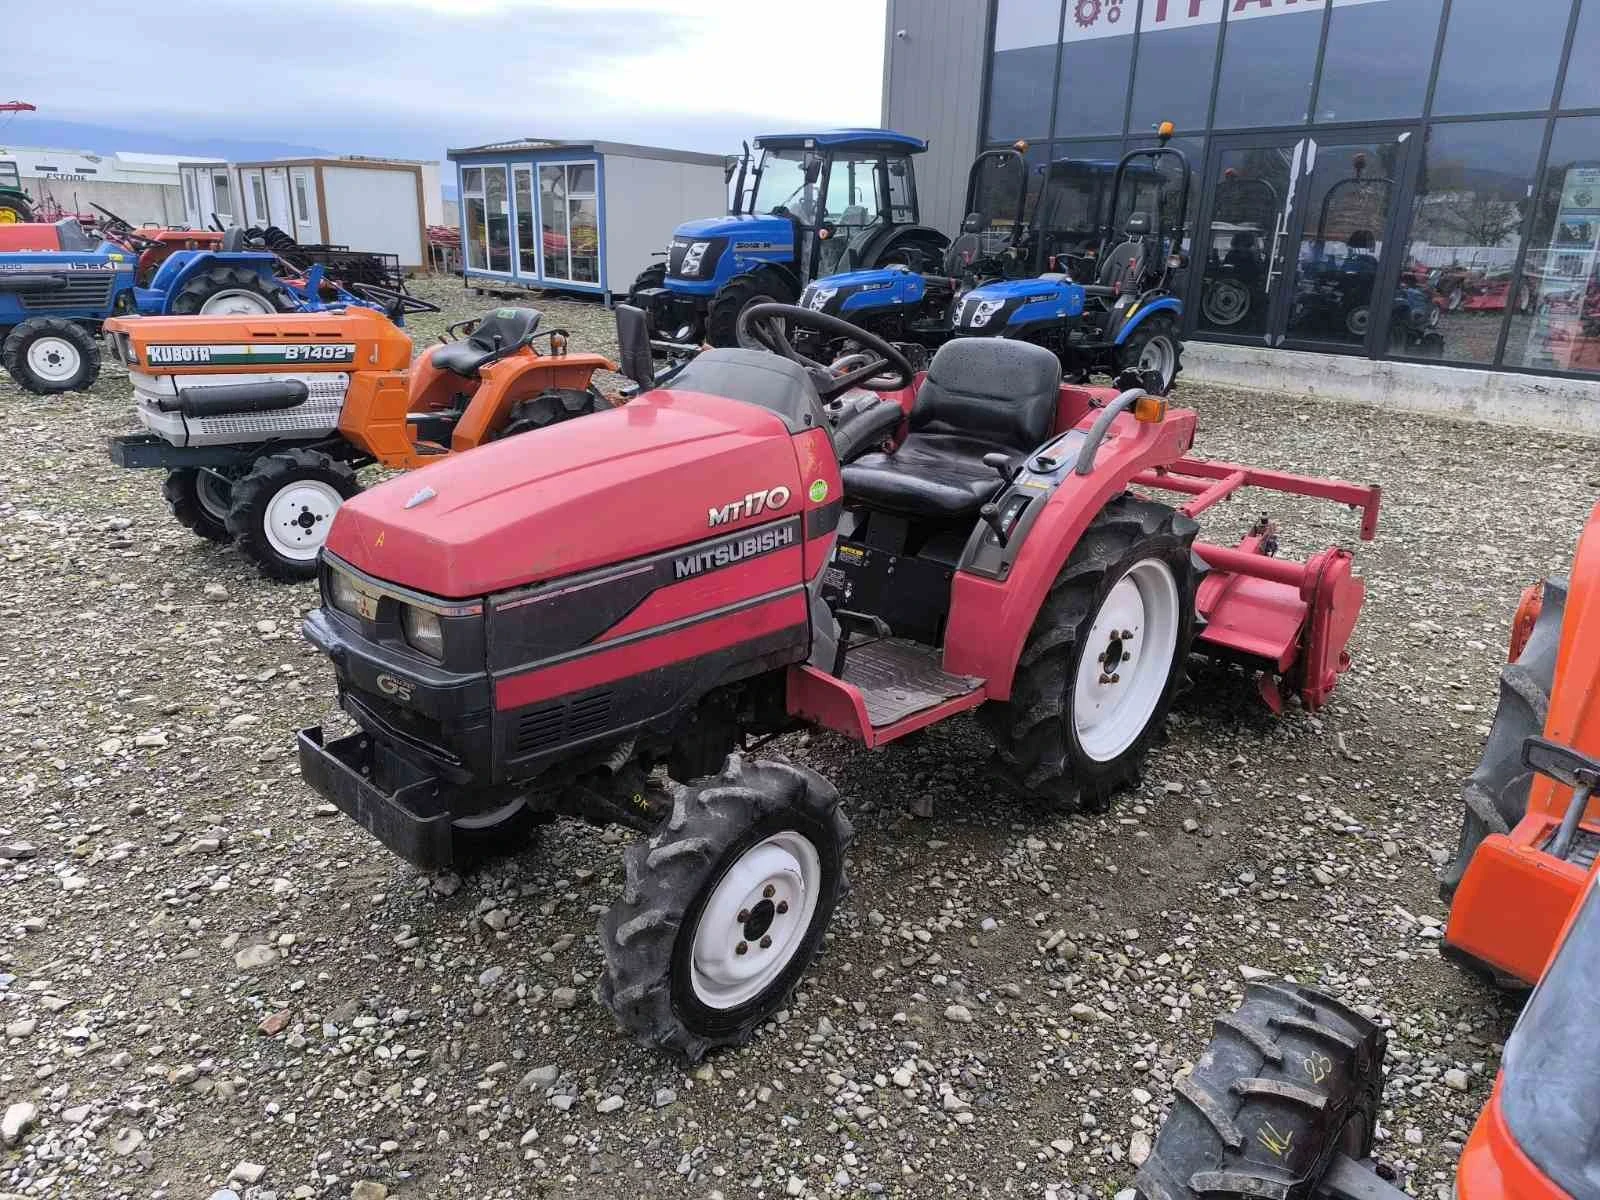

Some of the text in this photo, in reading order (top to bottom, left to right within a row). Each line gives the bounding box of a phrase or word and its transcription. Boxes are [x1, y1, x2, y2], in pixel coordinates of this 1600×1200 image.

[150, 345, 347, 362] KUBOTA B1402
[708, 485, 791, 528] MT170
[675, 526, 793, 579] MITSUBISHI
